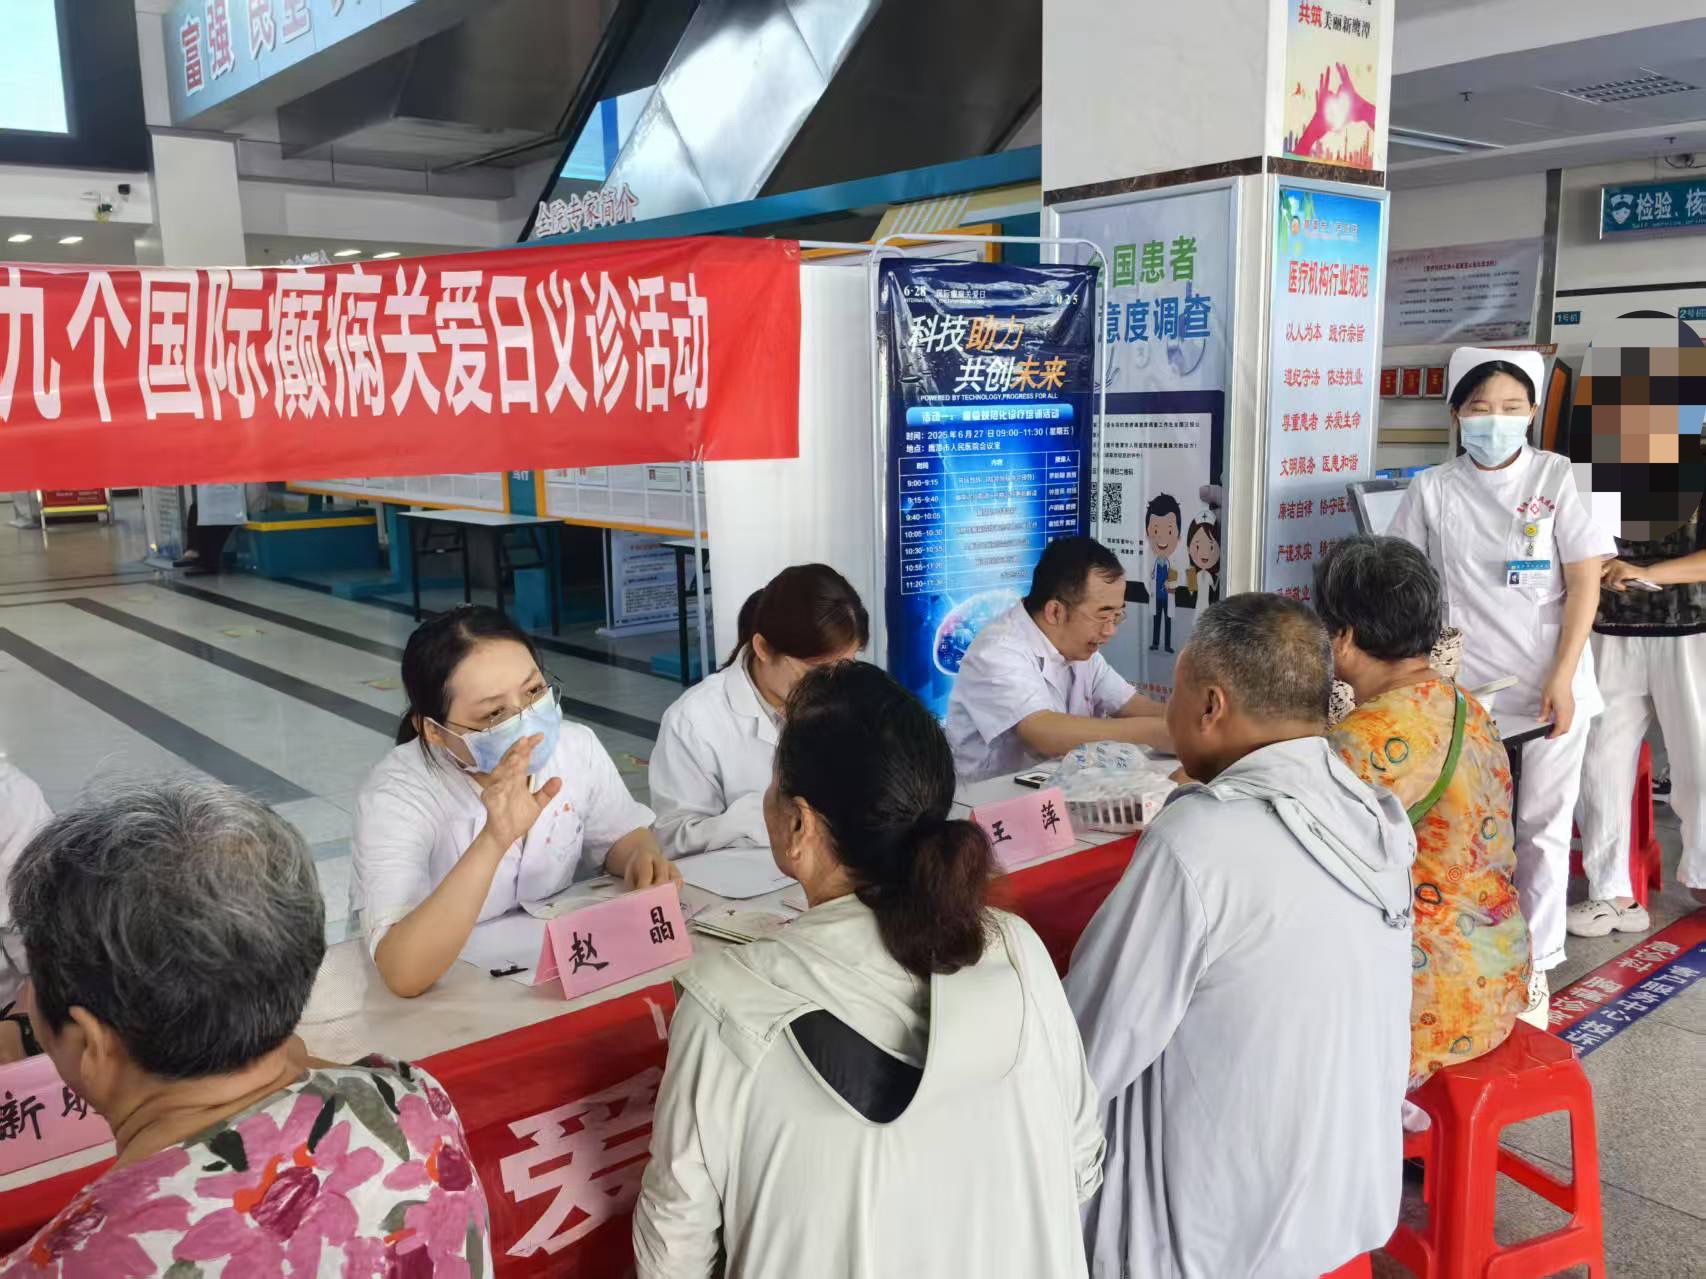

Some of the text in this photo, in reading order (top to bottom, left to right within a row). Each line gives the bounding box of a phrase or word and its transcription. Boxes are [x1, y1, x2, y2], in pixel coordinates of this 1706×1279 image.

[535, 183, 638, 237] 全院专家简介
[1288, 261, 1370, 299] 医疗机构行业规范
[0, 263, 709, 423] 九个国际癫痫关爱日义诊活动
[908, 314, 1025, 353] 科技助力
[1286, 322, 1366, 343] 以人为本 践行宗旨
[953, 355, 1068, 393] 共创未来
[1283, 368, 1320, 387] 遵纪守法
[1327, 368, 1364, 387] 依法执业
[1281, 410, 1361, 432] 尊重患者 关爱生命
[1280, 453, 1359, 476] 文明服务 医患和谐
[1278, 500, 1313, 520] 廉洁自律
[1276, 542, 1312, 564] 严谨求实
[991, 799, 1060, 845] 王 萍
[568, 905, 675, 975] 赵 晶
[1616, 940, 1680, 972] 急诊科
[1600, 965, 1700, 1021] 客户服务中心
